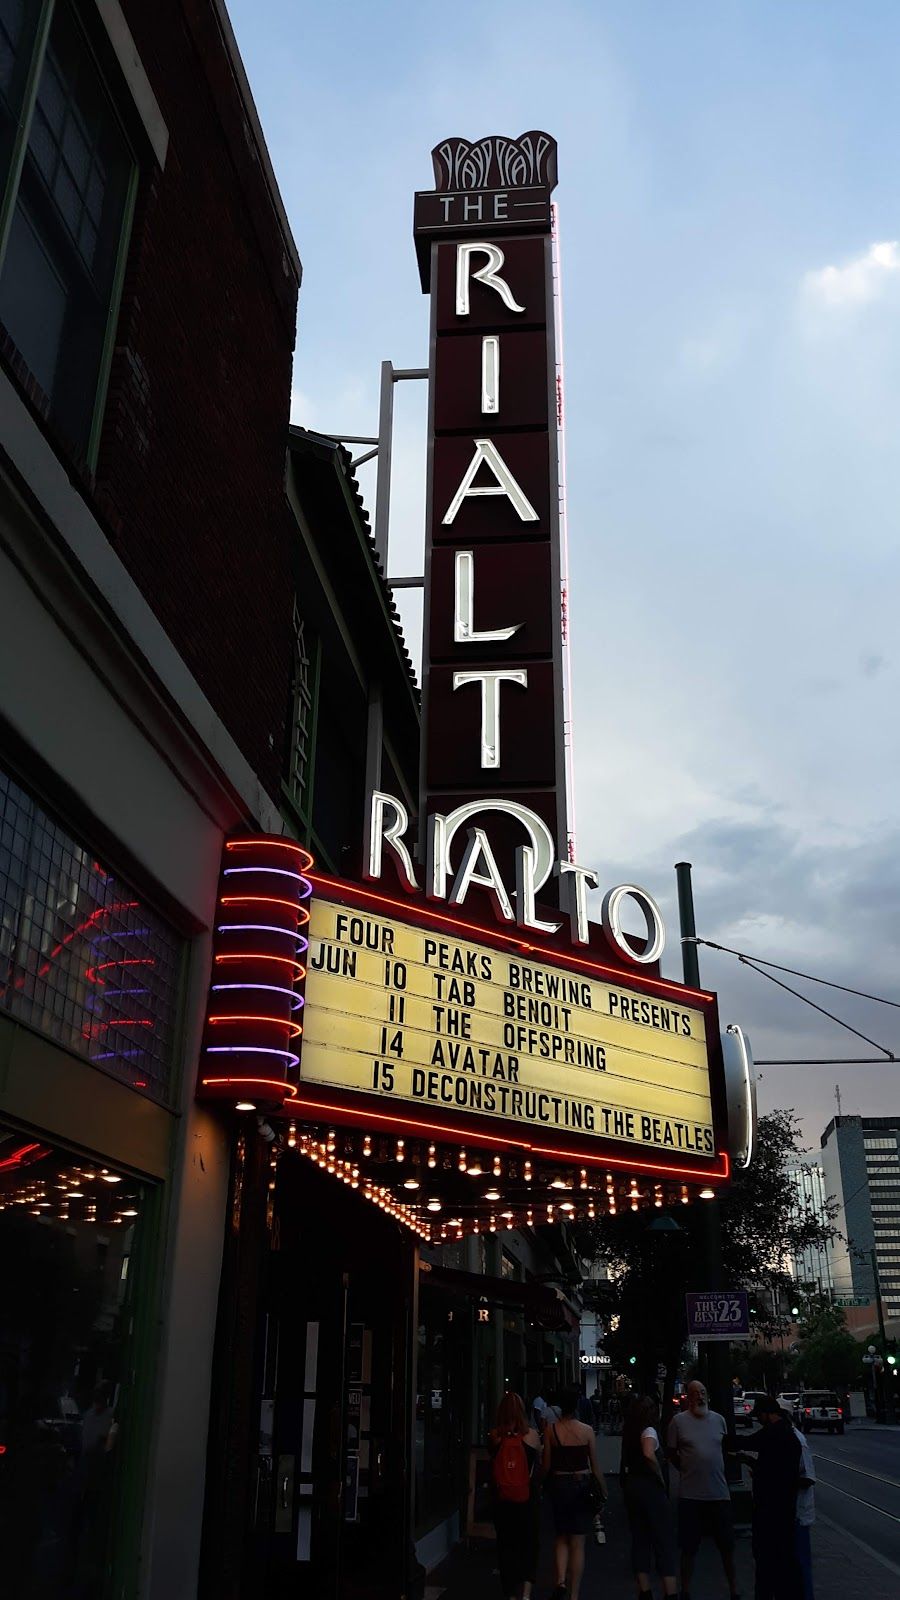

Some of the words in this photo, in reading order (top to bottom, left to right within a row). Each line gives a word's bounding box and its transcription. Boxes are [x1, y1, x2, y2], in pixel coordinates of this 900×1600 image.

[440, 194, 508, 222] THE
[440, 241, 556, 897] RIALTO
[363, 789, 666, 965] RIALTO
[311, 943, 357, 978] JUN
[385, 960, 407, 990] 10
[434, 973, 476, 1008] TAB
[503, 992, 572, 1032] BENOIT
[336, 914, 394, 954] FOUR
[424, 939, 492, 980] PEAKS
[509, 963, 592, 1008] BREWING
[608, 992, 692, 1036] PRESENTS
[381, 1027, 404, 1058] 14
[431, 1039, 519, 1083] AVATAR
[389, 995, 405, 1024] 11
[433, 1005, 471, 1039] THE
[503, 1023, 606, 1071] OFFSPRING
[373, 1060, 395, 1092] 15
[412, 1068, 595, 1131] DECONSTRUCTING
[602, 1108, 634, 1138] THE
[641, 1116, 714, 1152] BEATLES
[694, 1311, 719, 1323] BEST
[695, 1301, 718, 1312] THE
[717, 1300, 742, 1322] 23
